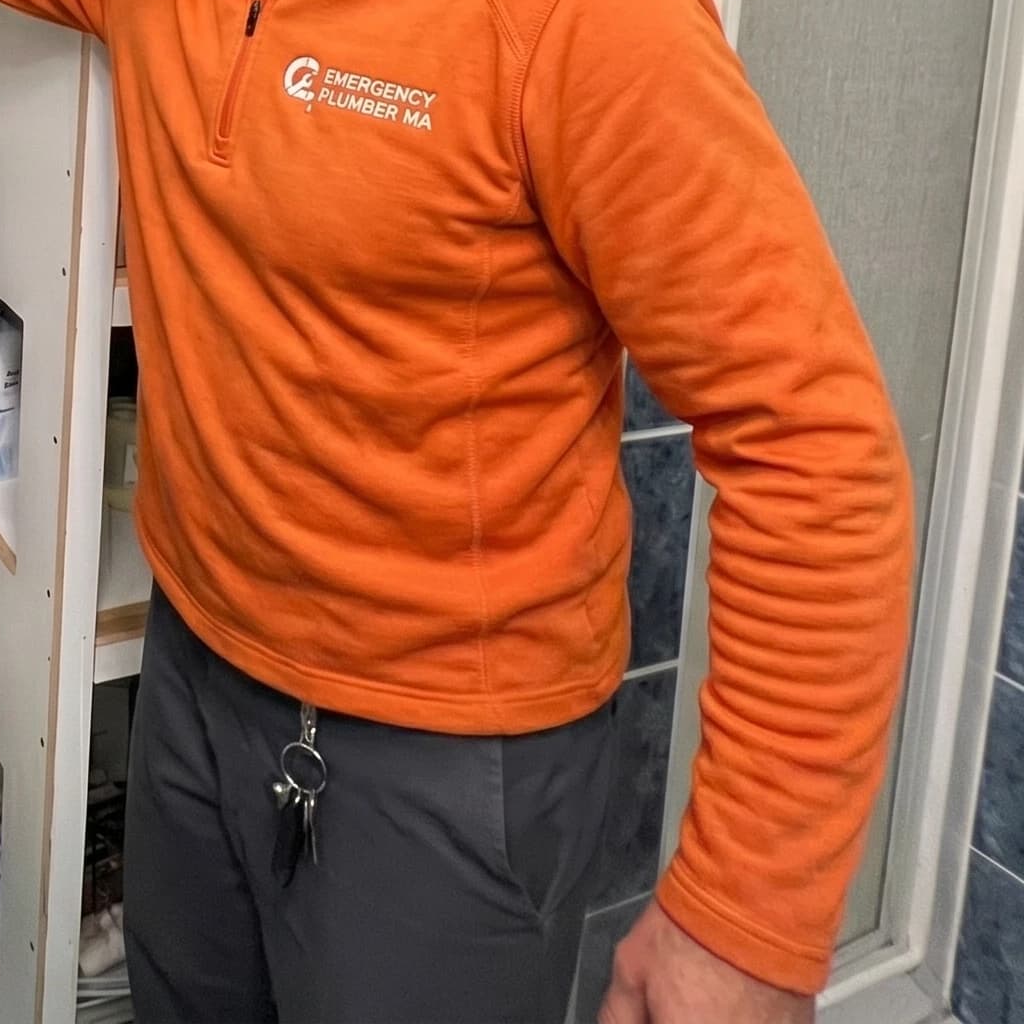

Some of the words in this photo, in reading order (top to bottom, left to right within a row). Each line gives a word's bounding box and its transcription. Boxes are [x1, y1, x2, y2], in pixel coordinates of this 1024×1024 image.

[317, 87, 399, 121] PLUMBER
[402, 109, 432, 131] MA
[323, 68, 436, 108] EMERGENCY
